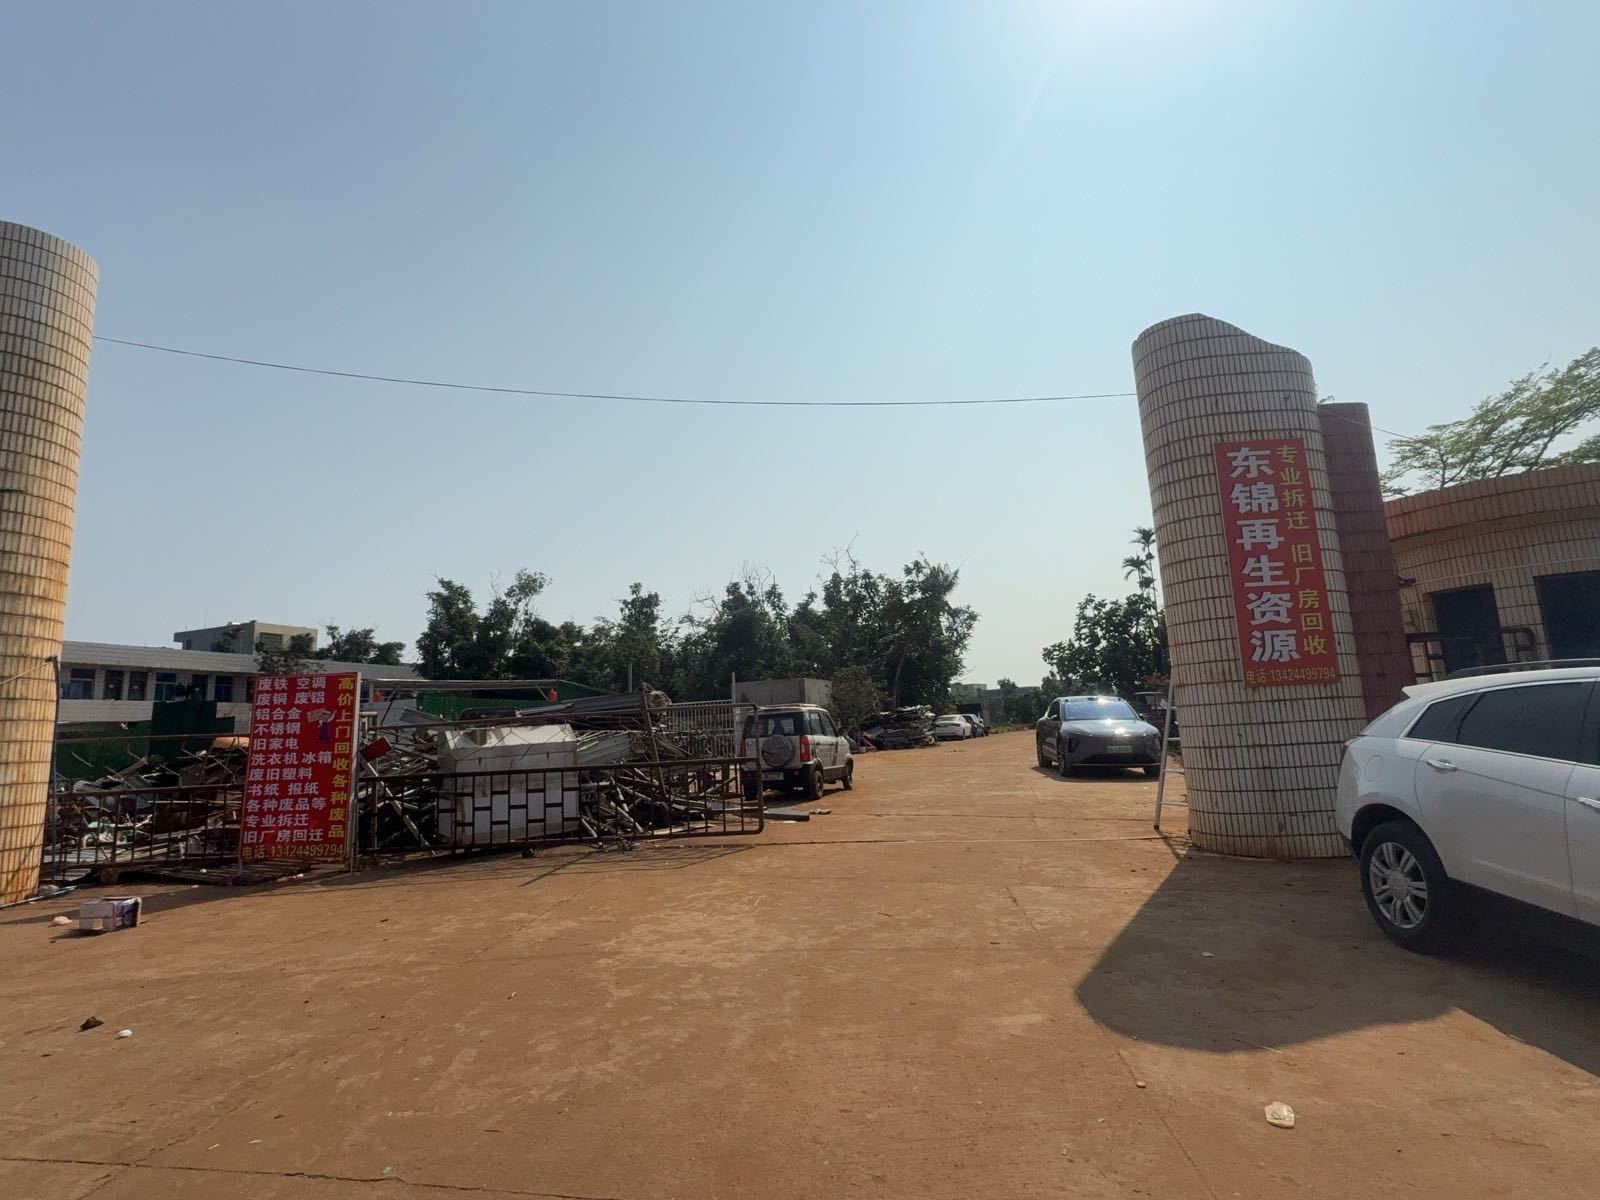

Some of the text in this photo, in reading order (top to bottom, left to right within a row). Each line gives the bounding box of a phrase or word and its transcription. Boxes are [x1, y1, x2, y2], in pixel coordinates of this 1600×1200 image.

[1226, 446, 1301, 663] 东锦再生资源
[1276, 445, 1328, 655] 专业拆迁 旧厂房回收
[258, 677, 326, 691] 废铁 空调
[256, 691, 325, 706] 废铜 废铝
[256, 708, 302, 721] 铝合金
[254, 723, 301, 736] 不锈钢
[253, 738, 299, 750] 旧家电
[251, 751, 332, 766] 洗衣机 冰箱
[328, 677, 354, 838] 高价上门回收各种废品
[249, 767, 313, 781] 废旧塑料
[247, 782, 319, 796] 书纸 报纸
[246, 797, 326, 812] 各种废品等
[244, 814, 309, 827] 专业拆迁
[243, 829, 324, 843] 旧厂房回迁
